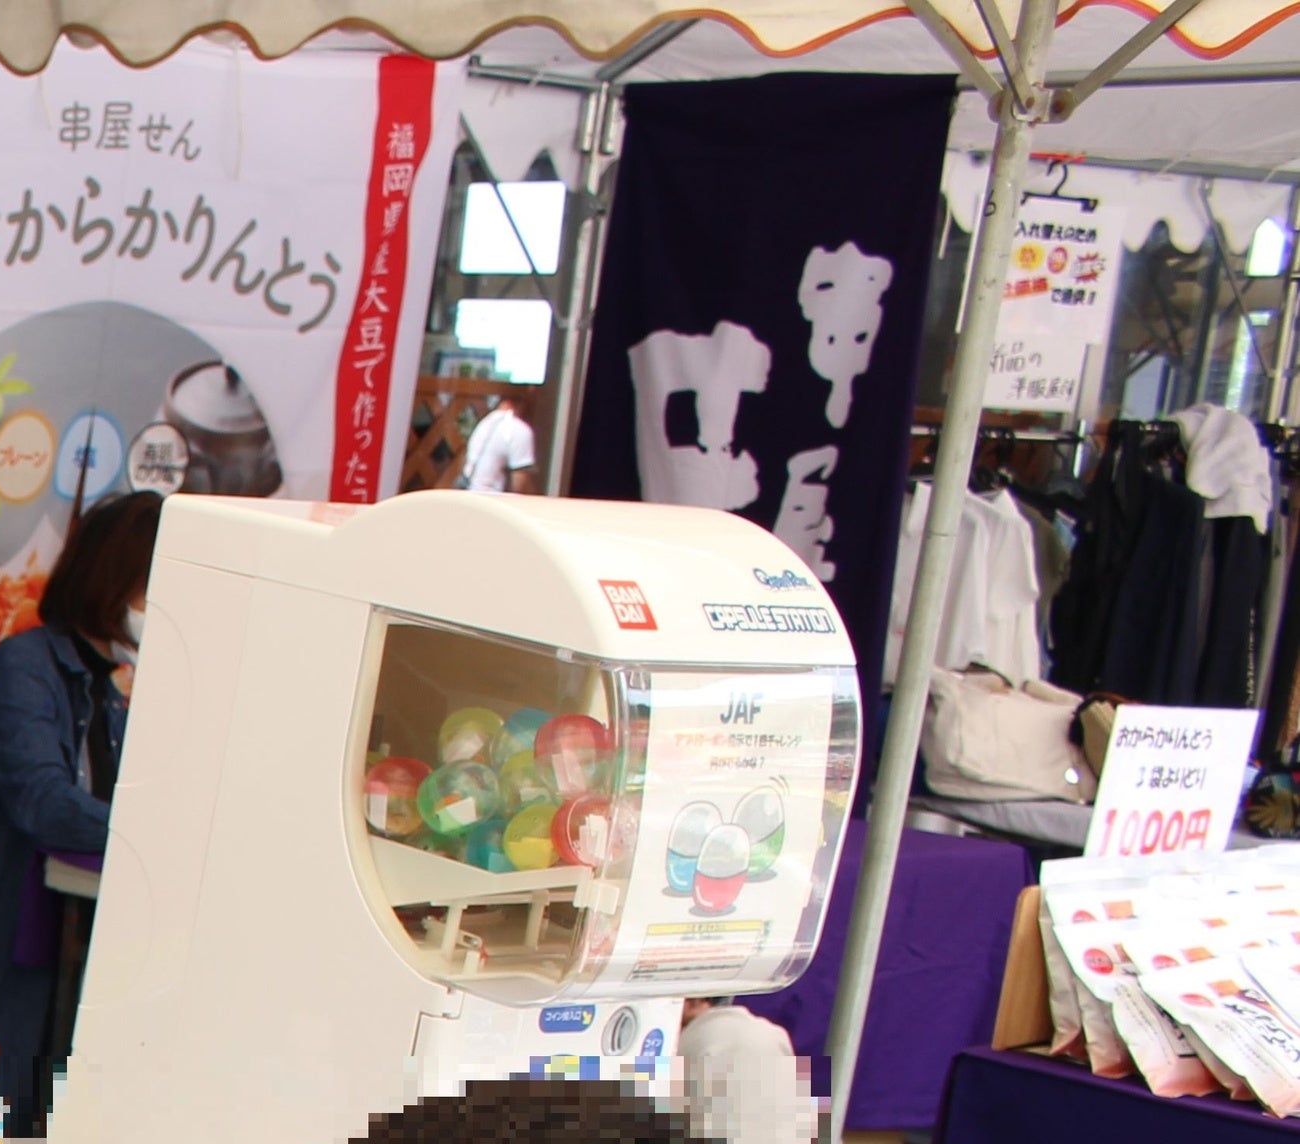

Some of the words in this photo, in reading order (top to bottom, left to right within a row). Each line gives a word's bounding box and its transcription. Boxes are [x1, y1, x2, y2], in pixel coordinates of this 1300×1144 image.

[58, 100, 203, 162] 串屋せん
[604, 586, 646, 604] BAN
[614, 604, 647, 624] DAI
[720, 692, 763, 724] JAF
[1117, 727, 1213, 750] おからかりんとう
[1099, 808, 1212, 857] 1000円
